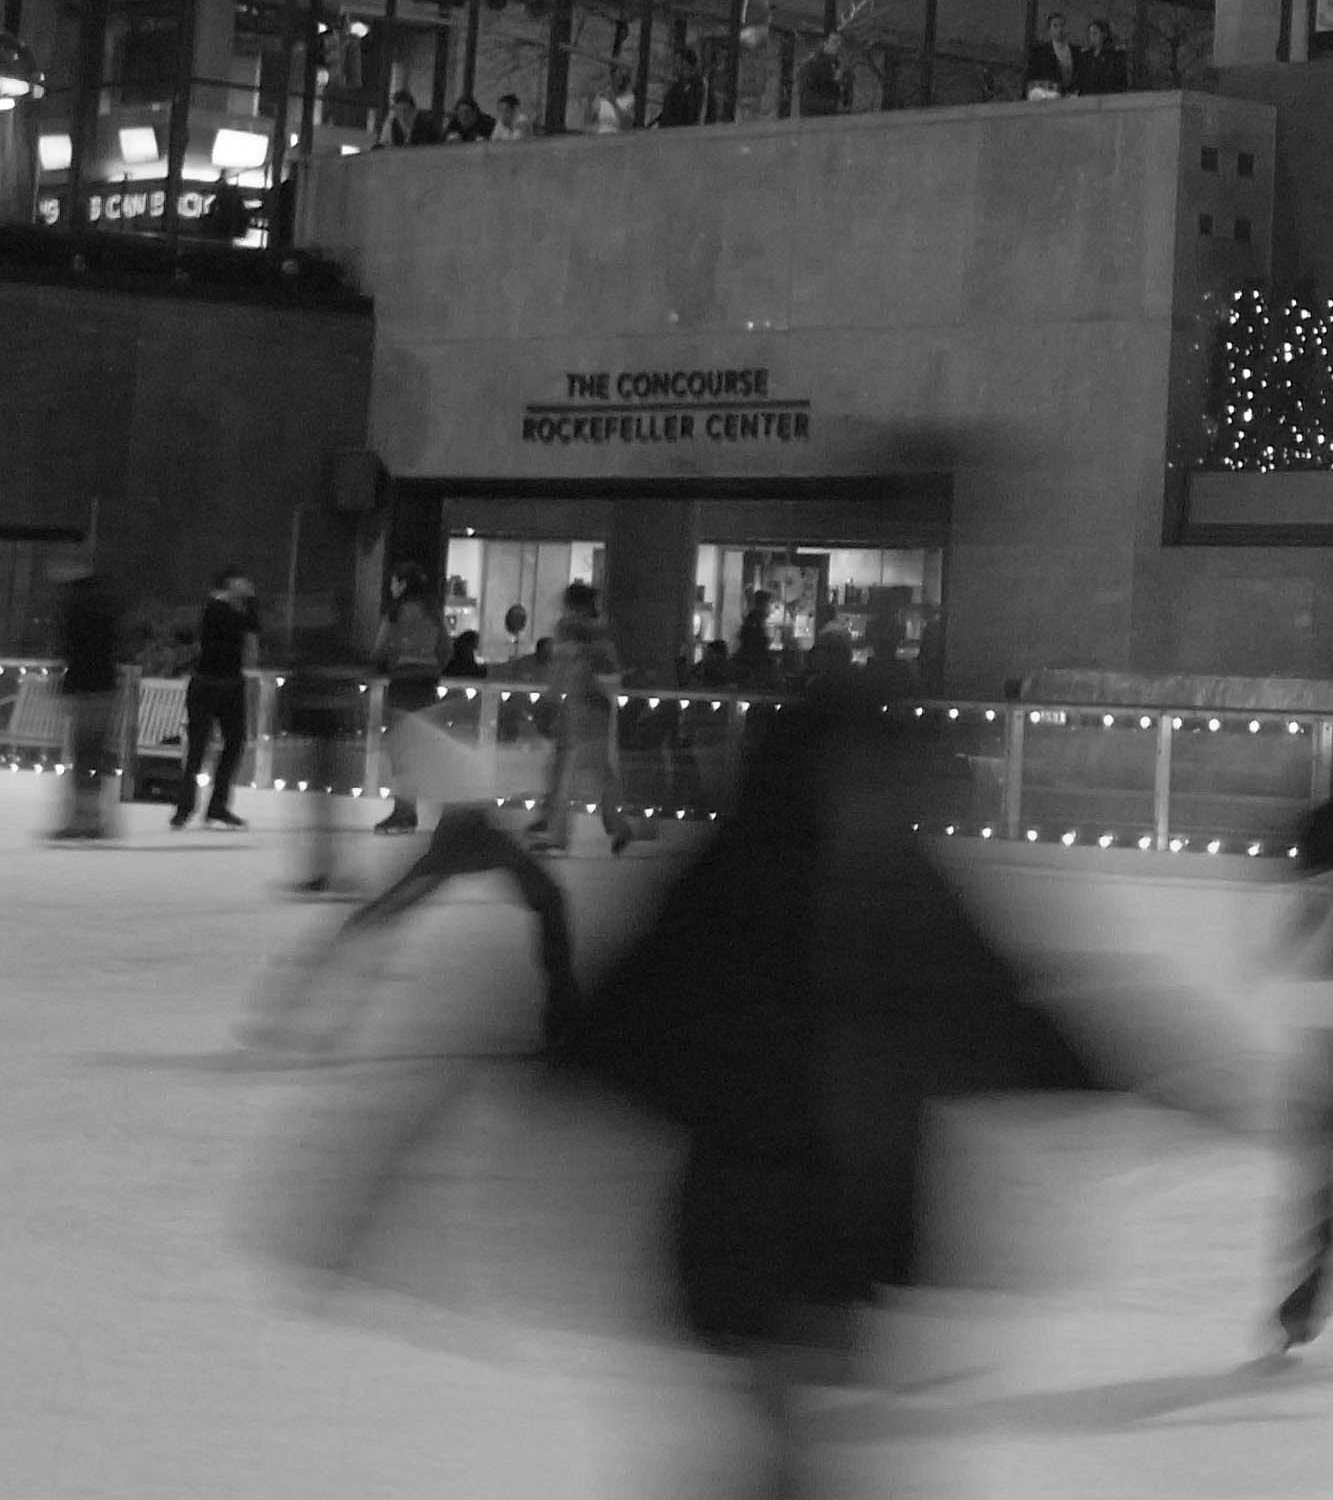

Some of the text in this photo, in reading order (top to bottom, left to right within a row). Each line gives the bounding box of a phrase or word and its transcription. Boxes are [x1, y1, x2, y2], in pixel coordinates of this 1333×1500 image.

[566, 368, 768, 399] THE CONCOURSE
[522, 411, 809, 444] ROCKEFELLER CENTER
